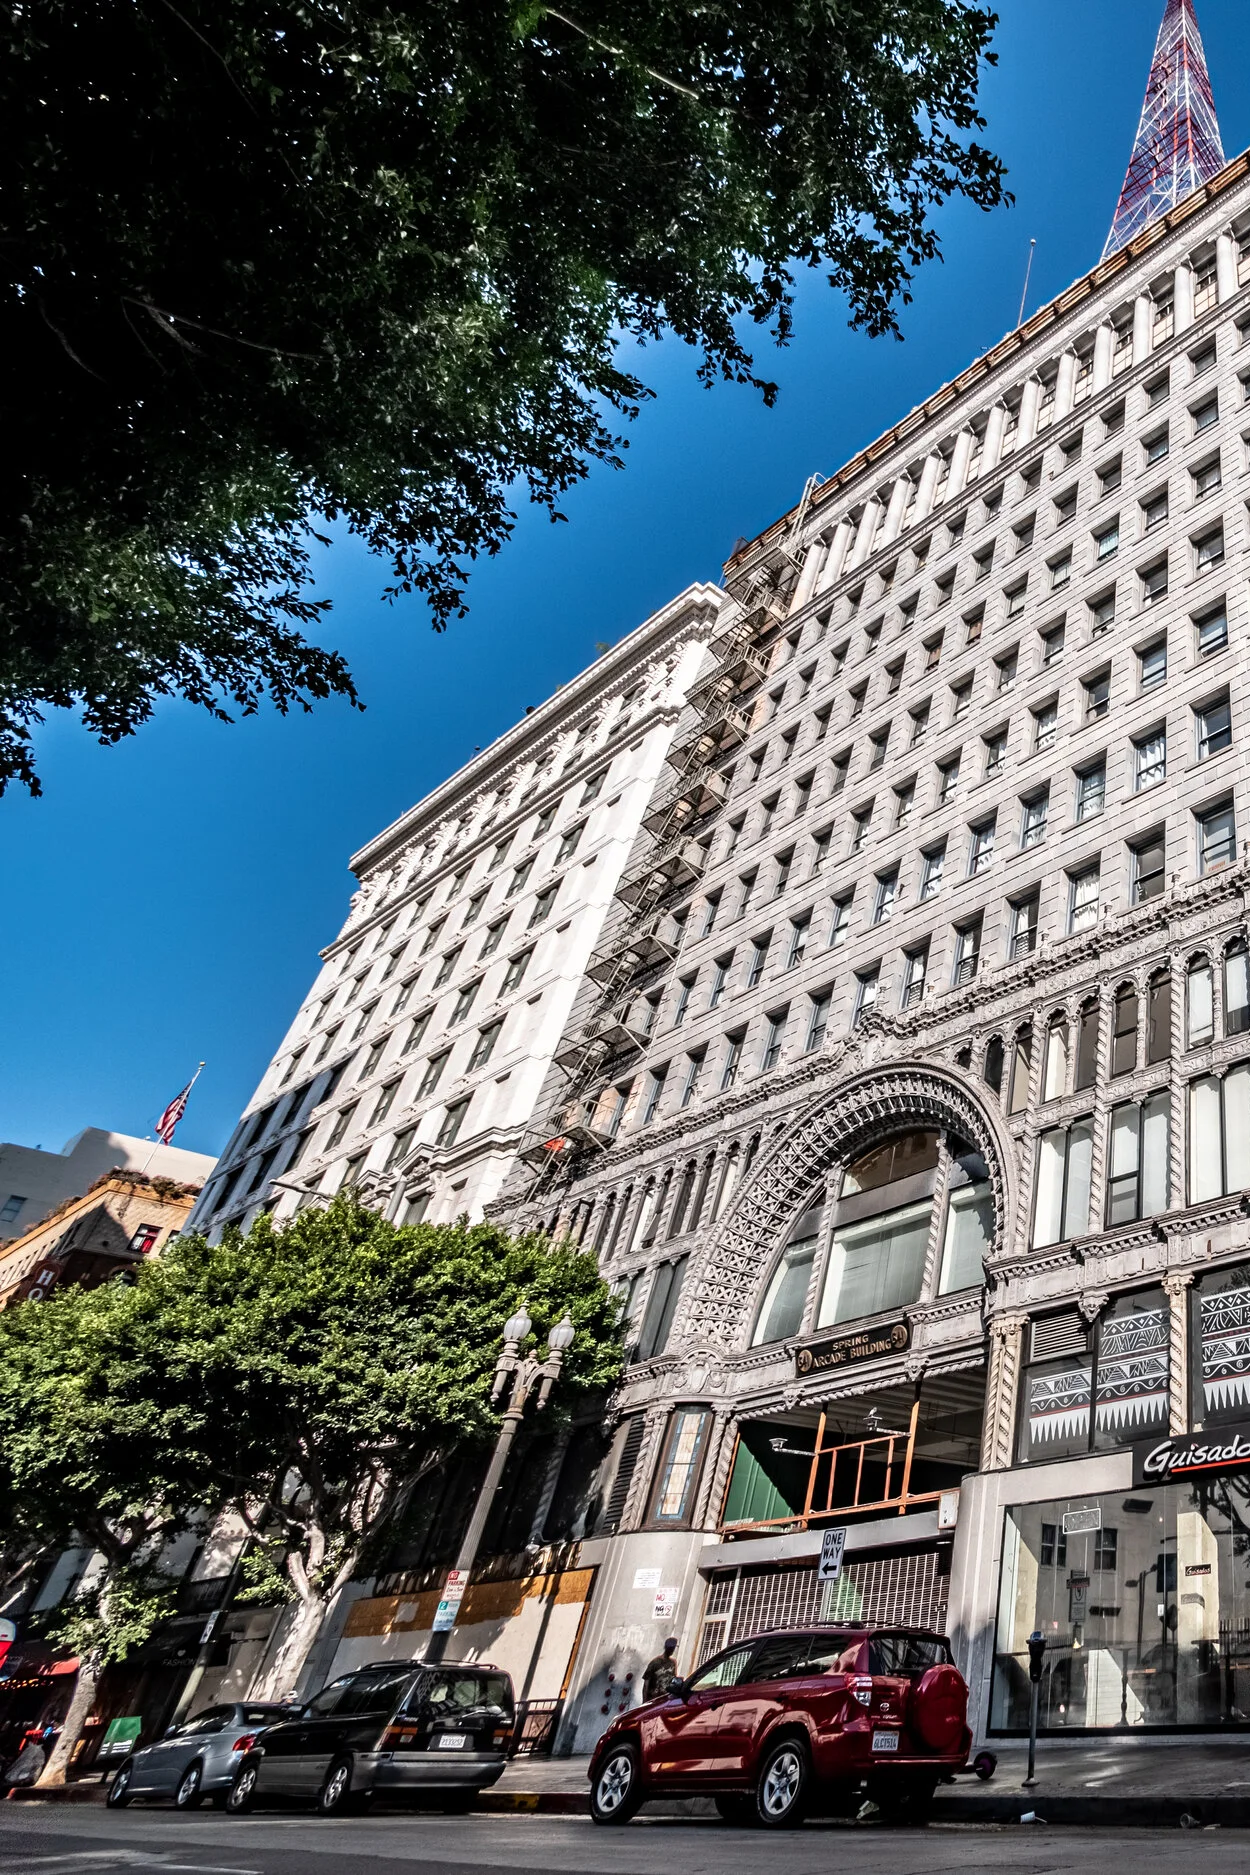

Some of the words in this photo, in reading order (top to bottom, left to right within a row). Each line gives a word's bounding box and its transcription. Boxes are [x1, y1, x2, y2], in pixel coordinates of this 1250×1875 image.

[832, 1334, 869, 1351] SPRING
[812, 1350, 847, 1369] ARCADE
[849, 1338, 892, 1360] BUILDING
[825, 1532, 843, 1546] ONE
[823, 1546, 842, 1560] WAY
